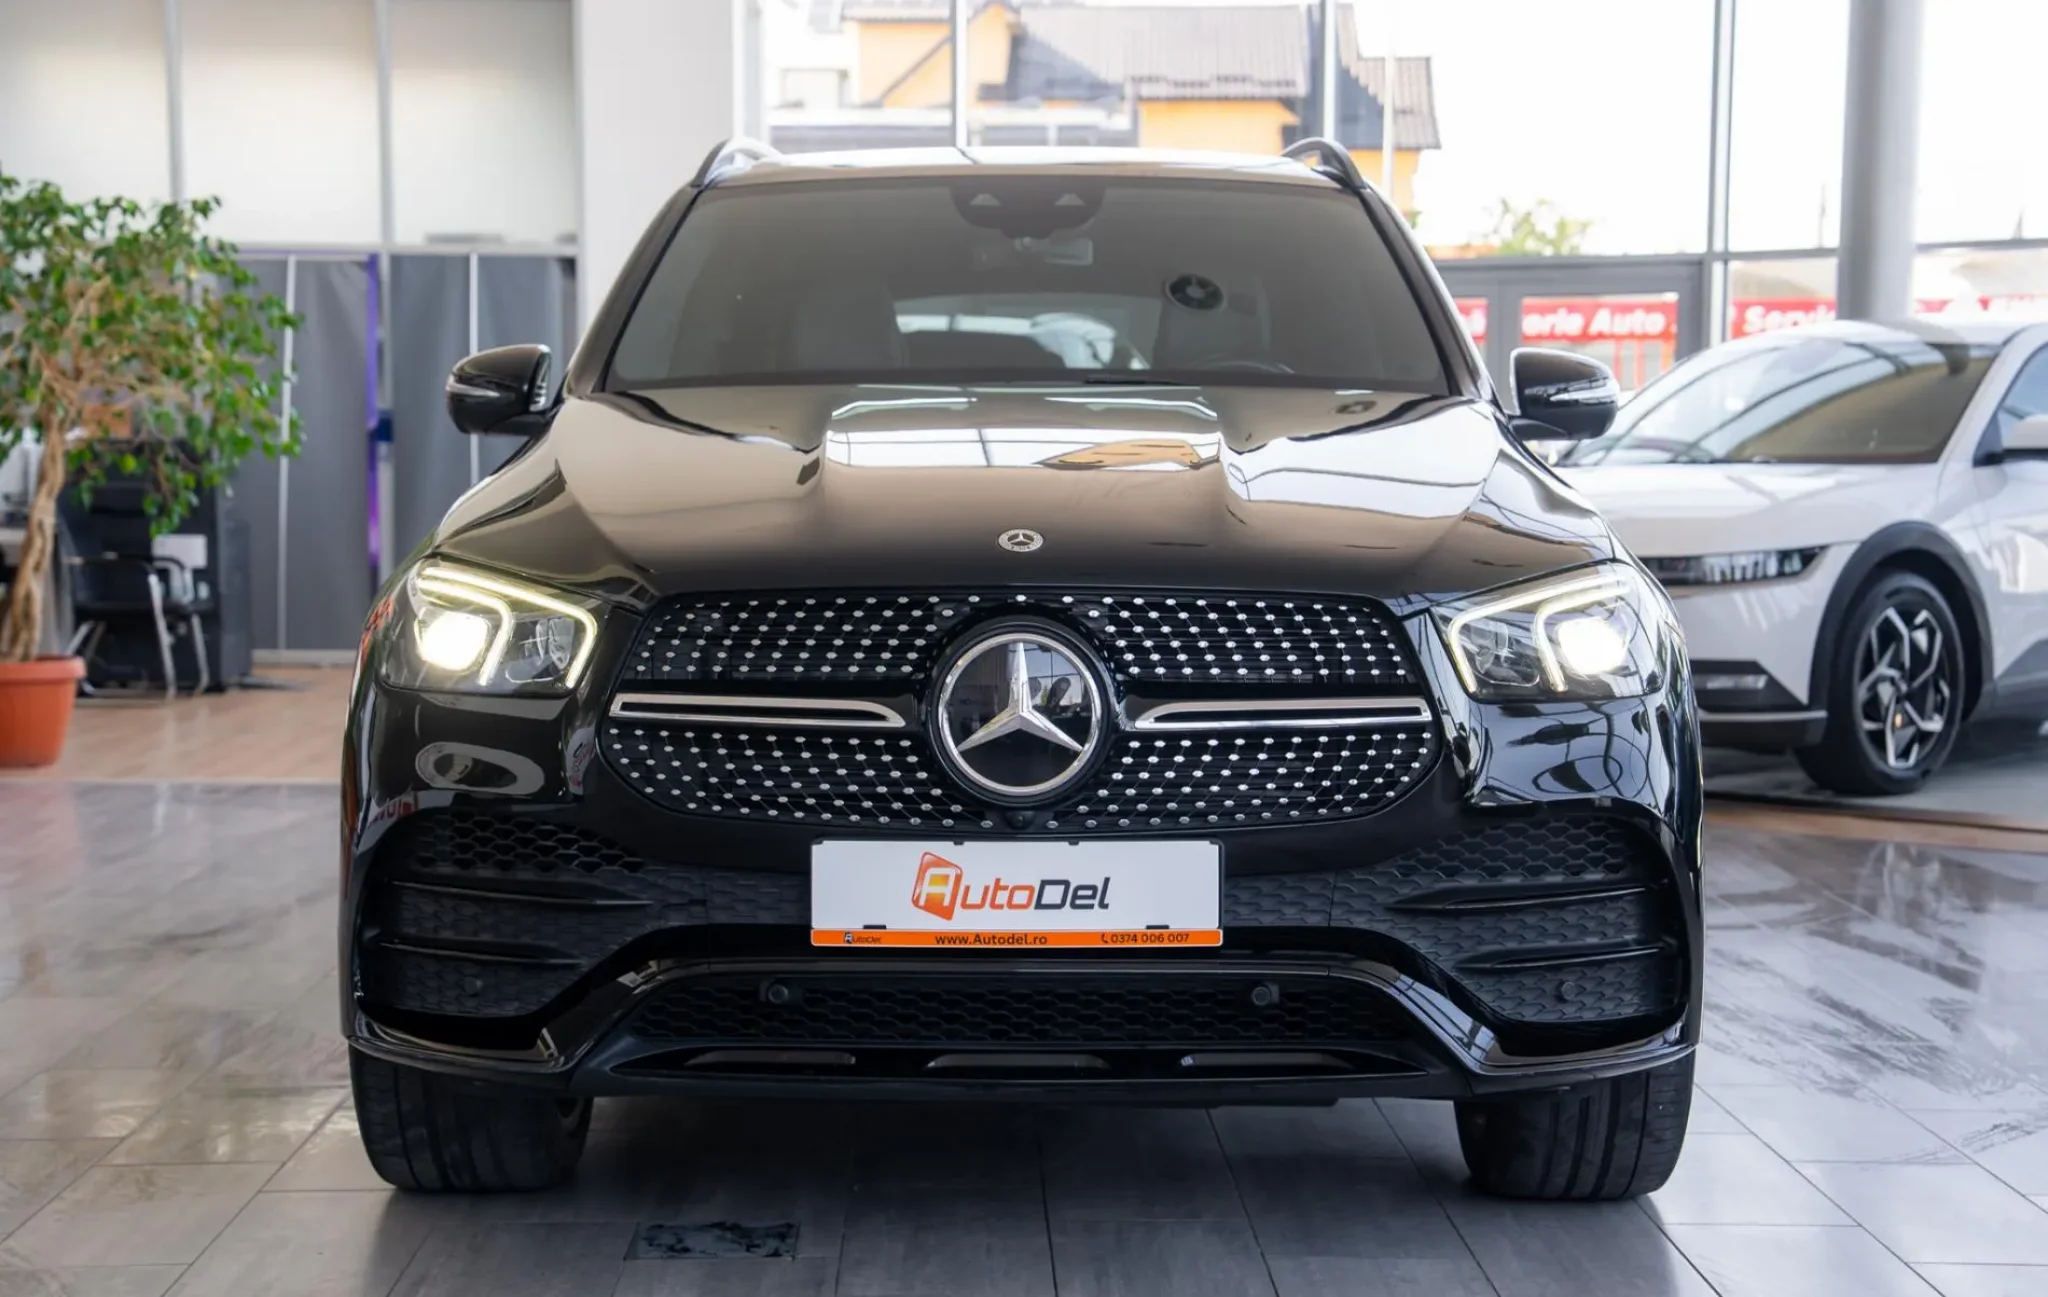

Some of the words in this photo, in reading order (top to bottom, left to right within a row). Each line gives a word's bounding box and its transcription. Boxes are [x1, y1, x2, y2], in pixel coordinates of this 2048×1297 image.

[1586, 308, 1666, 336] Auto
[914, 863, 1110, 911] AutoDel
[935, 933, 1048, 946] www.Autodel.ro
[1111, 933, 1138, 944] 0374
[1141, 933, 1165, 943] 006
[1167, 933, 1190, 943] 007
